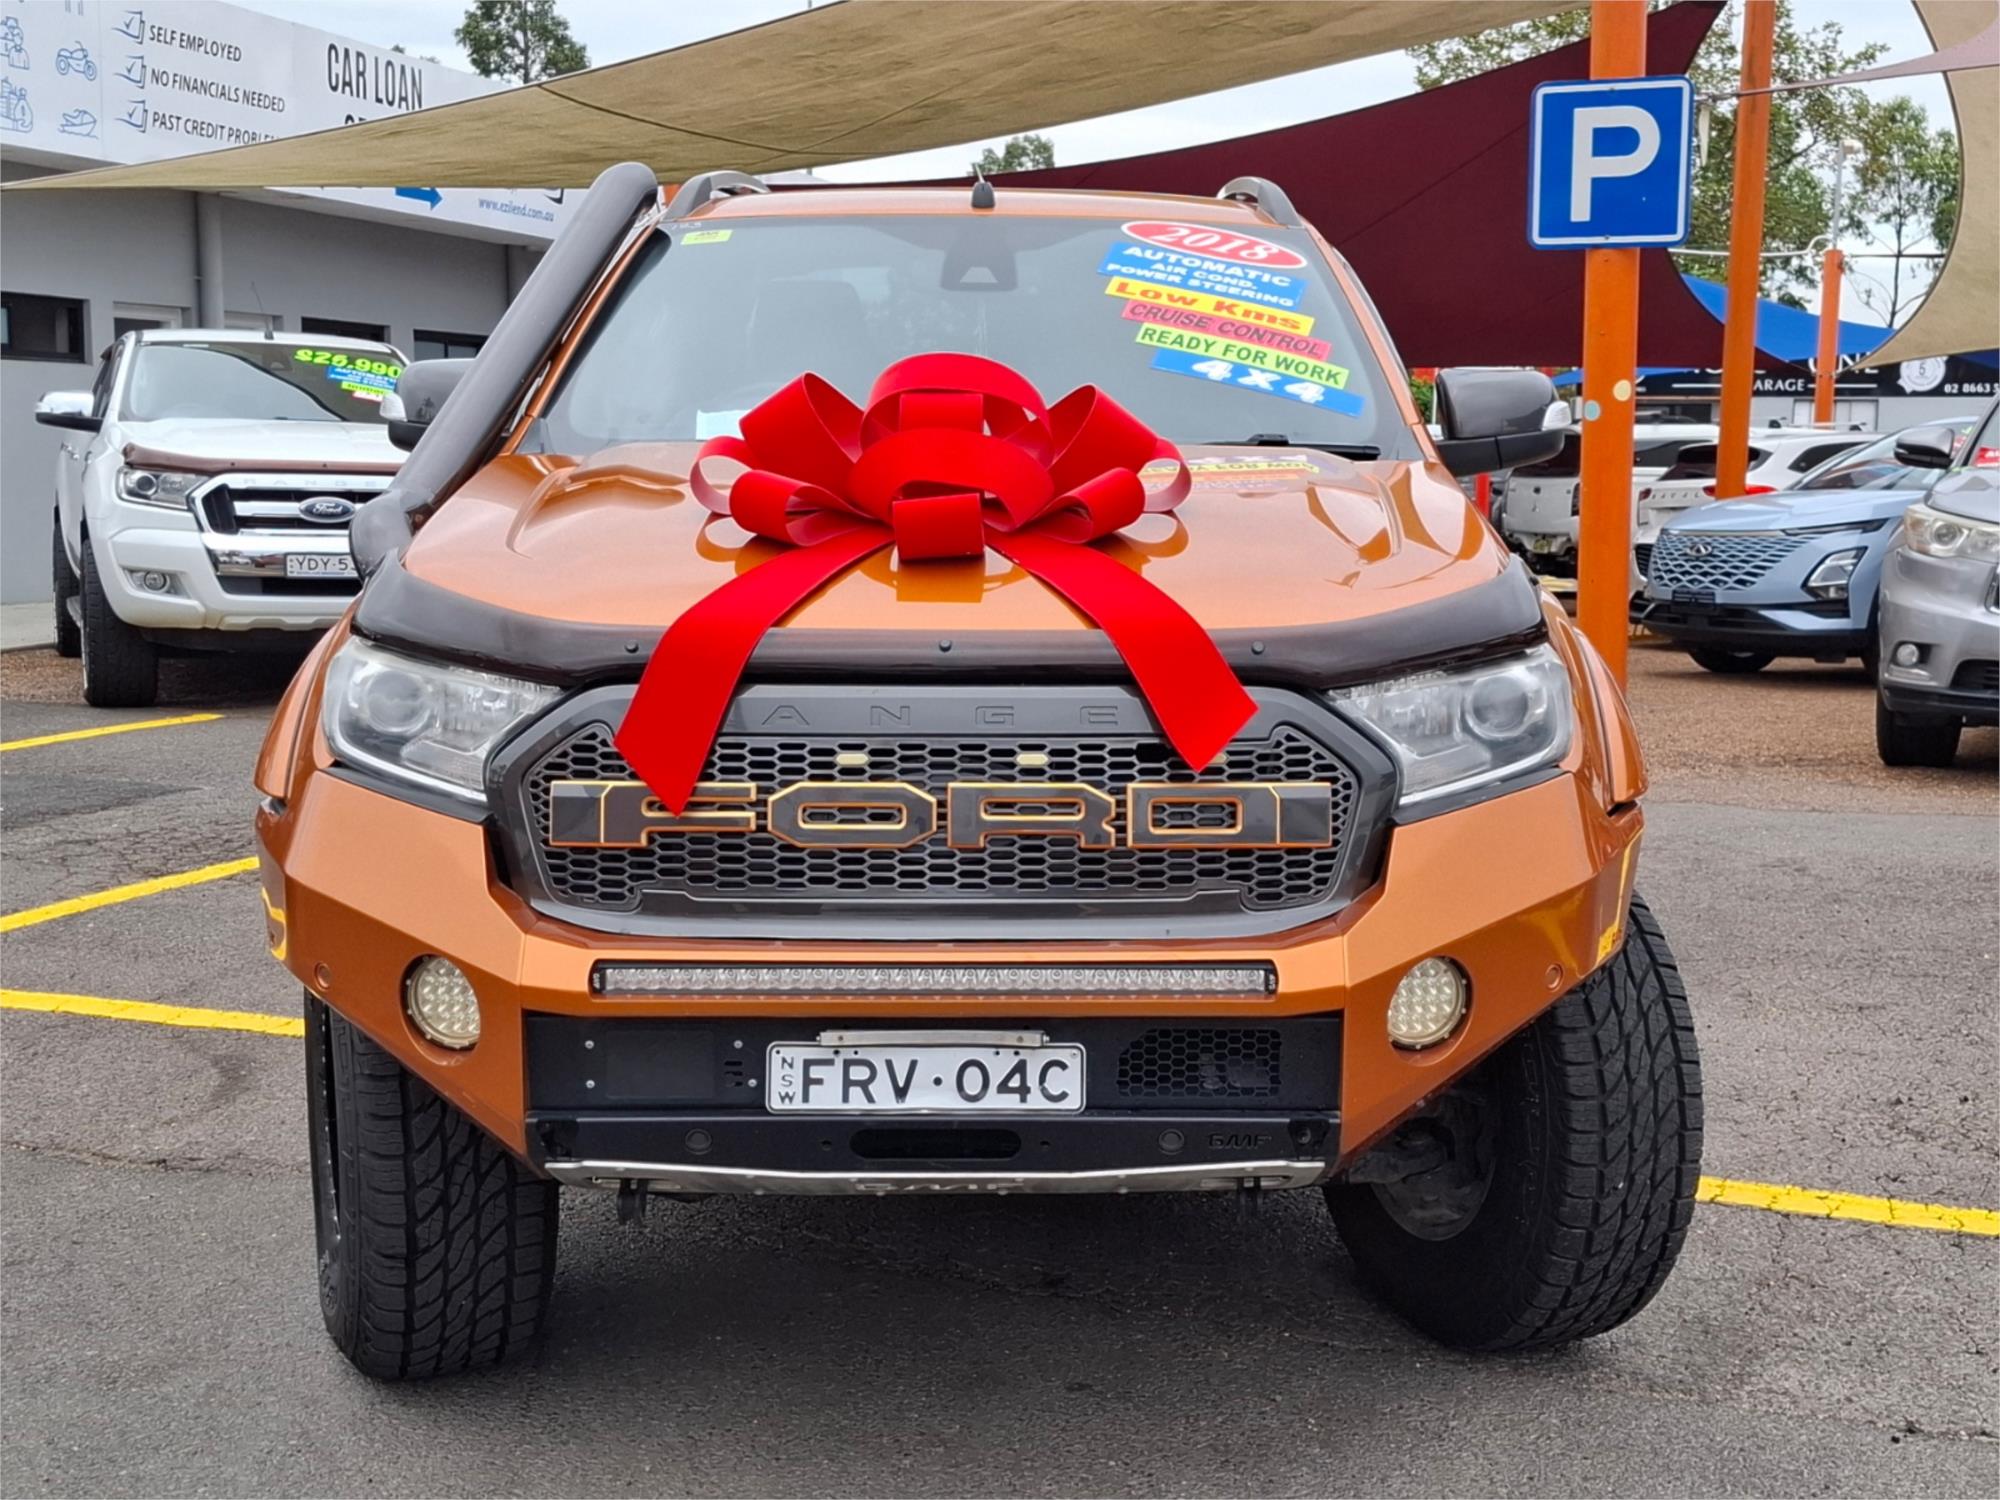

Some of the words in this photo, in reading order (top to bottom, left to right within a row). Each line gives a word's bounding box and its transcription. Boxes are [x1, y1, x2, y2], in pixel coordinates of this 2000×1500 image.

[149, 25, 177, 46] SELF
[179, 32, 242, 62] EMPLOYED
[151, 68, 170, 87] NO
[172, 73, 240, 103] FINANCIALS
[242, 89, 286, 113] NEEDED
[327, 43, 367, 100] CAR
[374, 56, 422, 111] LOAN
[152, 111, 182, 131] PAST
[184, 118, 226, 141] CREDIT
[1570, 105, 1661, 222] P
[1153, 227, 1280, 262] 2018
[1106, 263, 1182, 285] POWER
[1187, 279, 1295, 307] STEERING
[1122, 246, 1292, 287] AUTOMATIC
[1150, 261, 1188, 276] AIR
[1192, 269, 1258, 290] COND.
[1128, 303, 1212, 329] CRUISE
[1217, 321, 1323, 359] CONTROL
[1213, 299, 1301, 331] Kms
[1140, 327, 1216, 354] READY
[1221, 343, 1268, 365] FOR
[1275, 354, 1343, 386] WORK
[1753, 378, 1805, 392] ARAGE
[312, 502, 343, 515] Ford
[760, 704, 1119, 727] ANGE
[600, 780, 1284, 849] FORD
